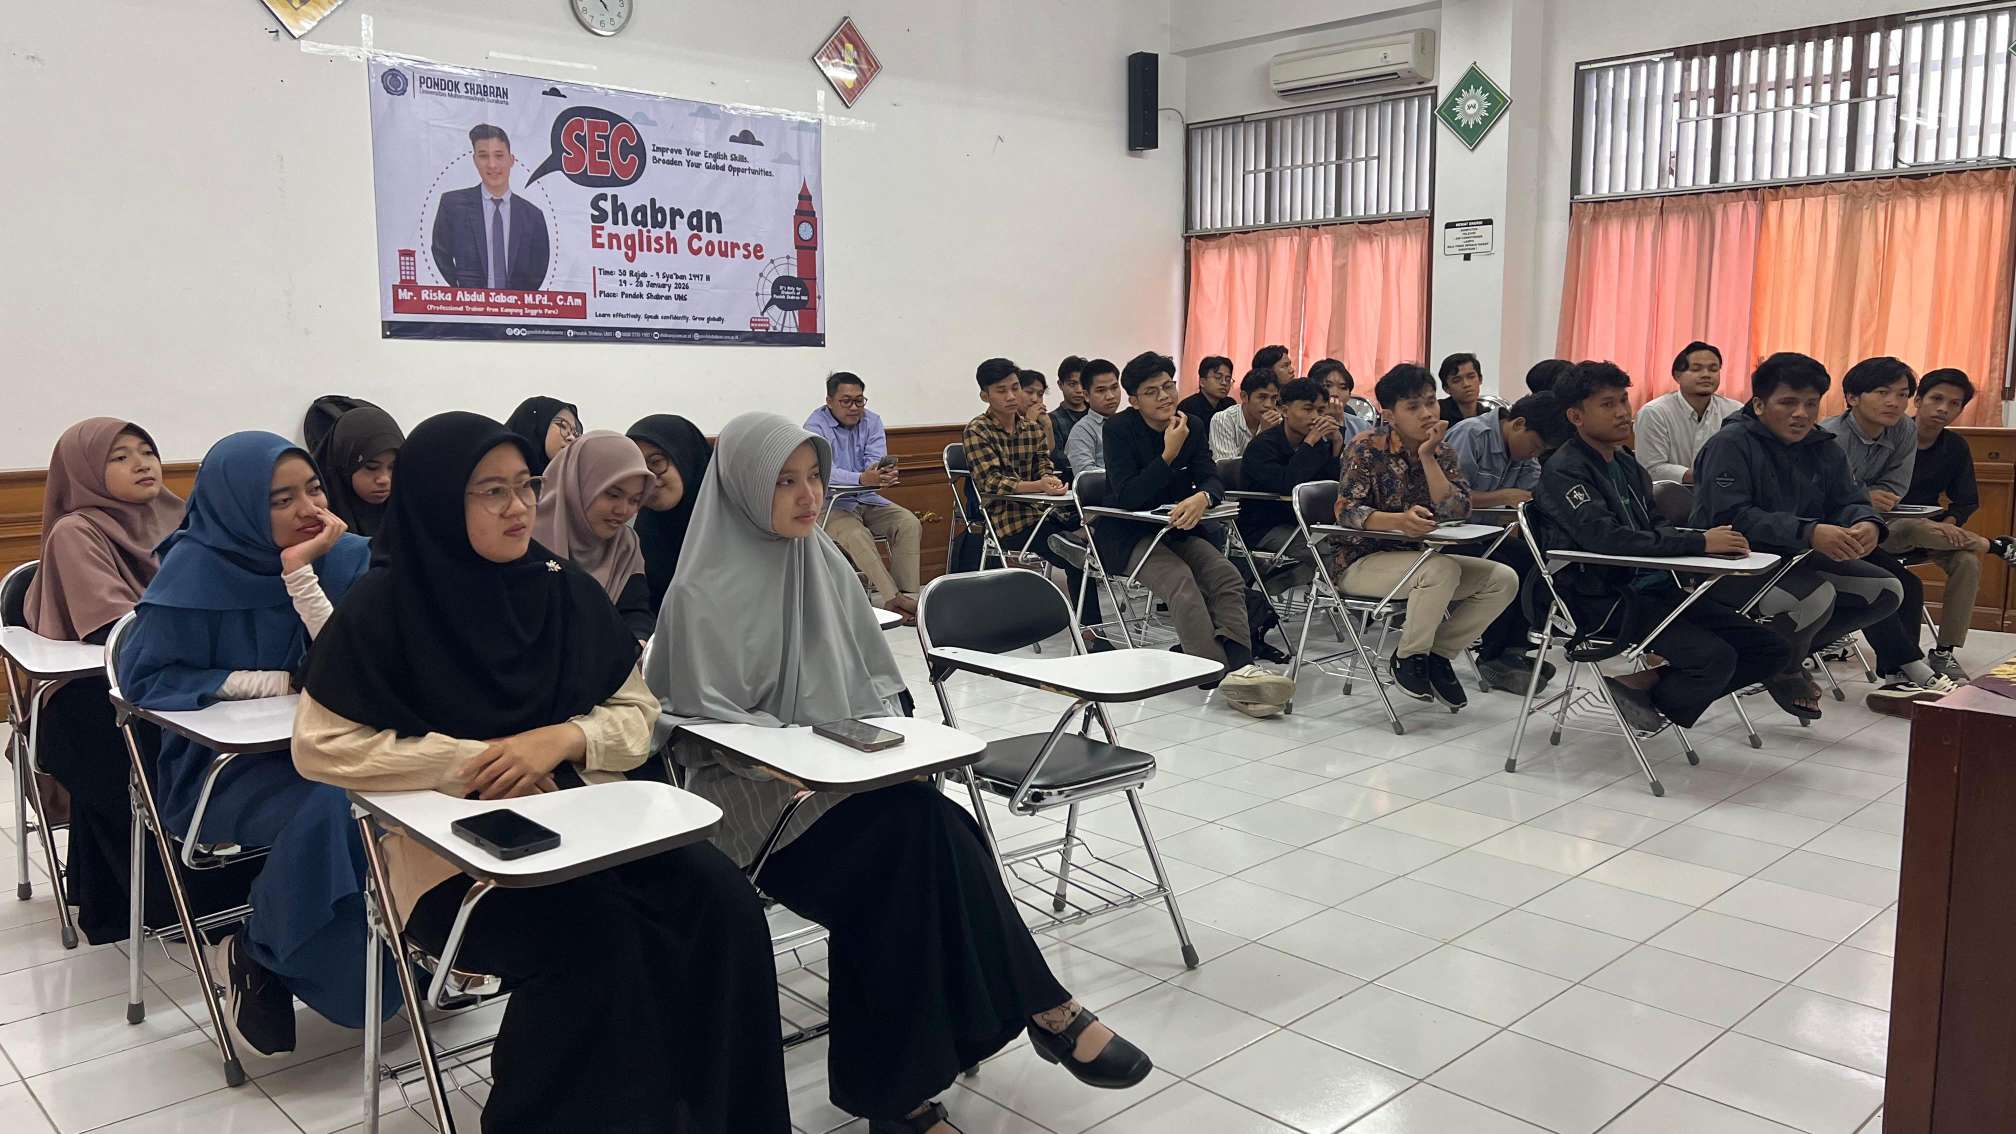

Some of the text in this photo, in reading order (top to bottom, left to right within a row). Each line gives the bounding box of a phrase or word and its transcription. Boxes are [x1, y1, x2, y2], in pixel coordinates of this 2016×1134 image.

[419, 75, 509, 100] PONDOK SHABRAN
[560, 116, 639, 180] SEC
[652, 144, 749, 163] Improve Your English Skills.
[652, 155, 775, 177] Broaden Your Global Opportunities.
[590, 192, 723, 234] Shabran
[591, 224, 765, 263] English Course
[598, 268, 616, 276] Time:
[618, 269, 627, 277] 30
[629, 269, 648, 281] Rajab
[688, 273, 704, 281] 1447
[598, 290, 618, 298] Place:
[620, 291, 644, 300] Pondok
[646, 292, 672, 301] Shabran
[645, 281, 672, 293] January
[674, 282, 690, 290] 2026
[398, 288, 417, 300] Mr.
[421, 289, 451, 301] Riska
[456, 290, 485, 303] Abdul
[488, 292, 521, 305] Jabar,
[556, 295, 582, 306] C.Am
[426, 303, 464, 312] (Professional
[644, 313, 659, 322] Speak
